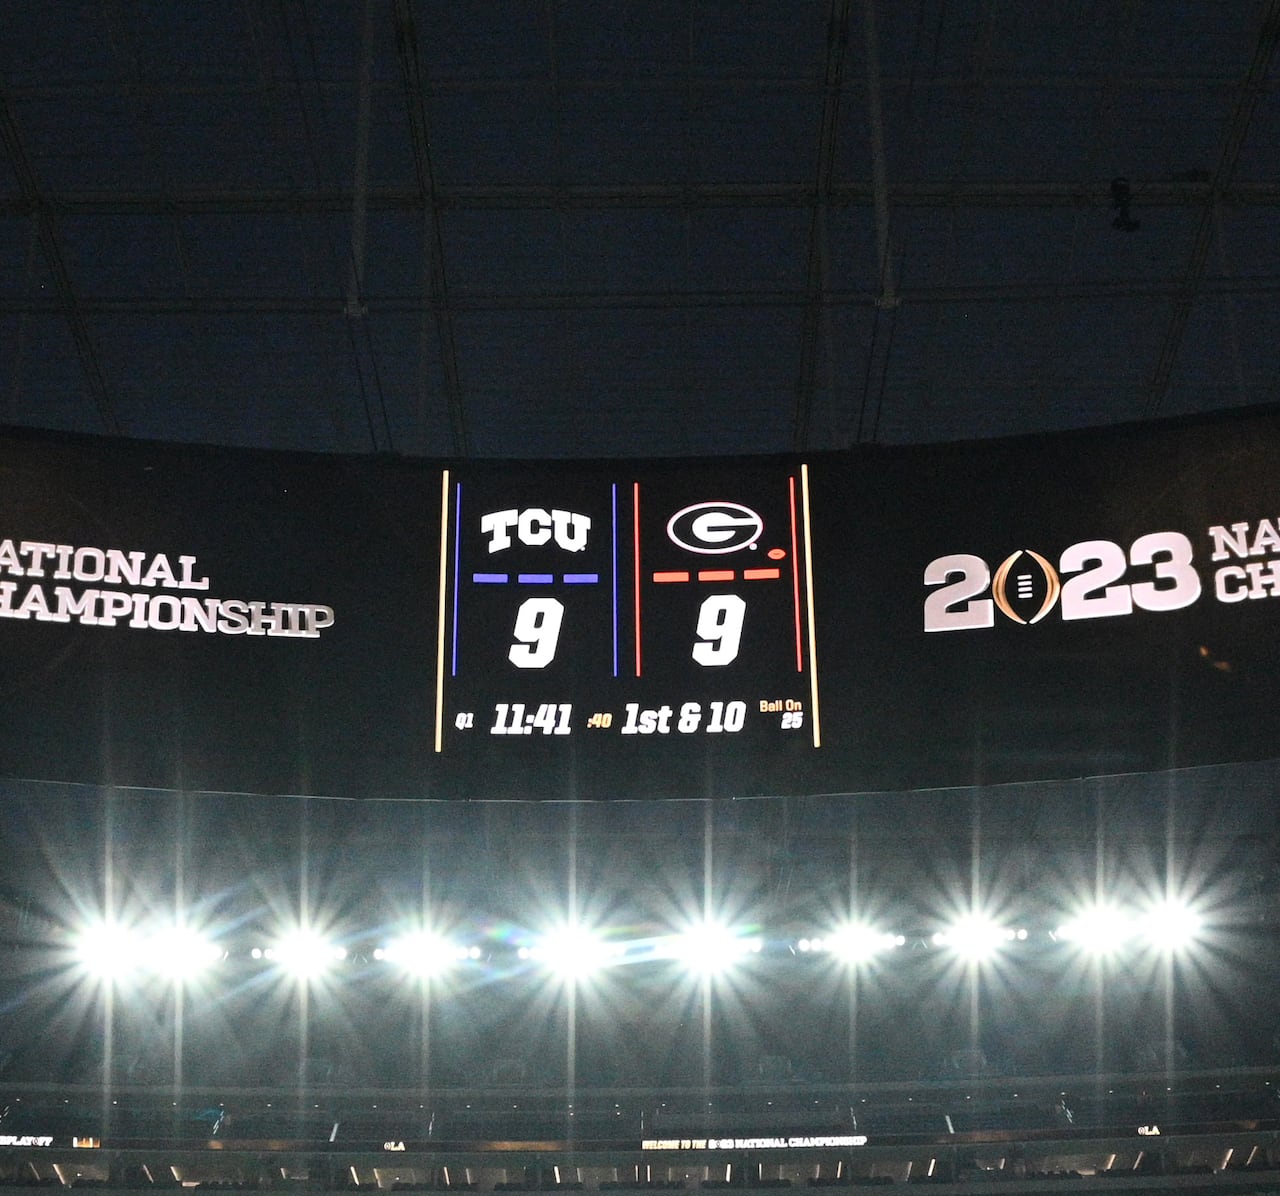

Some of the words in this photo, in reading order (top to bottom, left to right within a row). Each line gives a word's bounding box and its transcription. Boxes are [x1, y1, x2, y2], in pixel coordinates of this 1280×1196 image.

[480, 508, 591, 554] TCU
[508, 597, 565, 669] 9
[691, 594, 747, 667] 9
[455, 712, 473, 730] Q1
[490, 703, 572, 735] 11:41
[587, 713, 612, 728] :40
[621, 703, 673, 734] 1st
[678, 703, 702, 733] &
[707, 701, 746, 732] 10
[759, 699, 782, 712] Ball
[784, 699, 802, 712] On
[781, 713, 804, 729] 25
